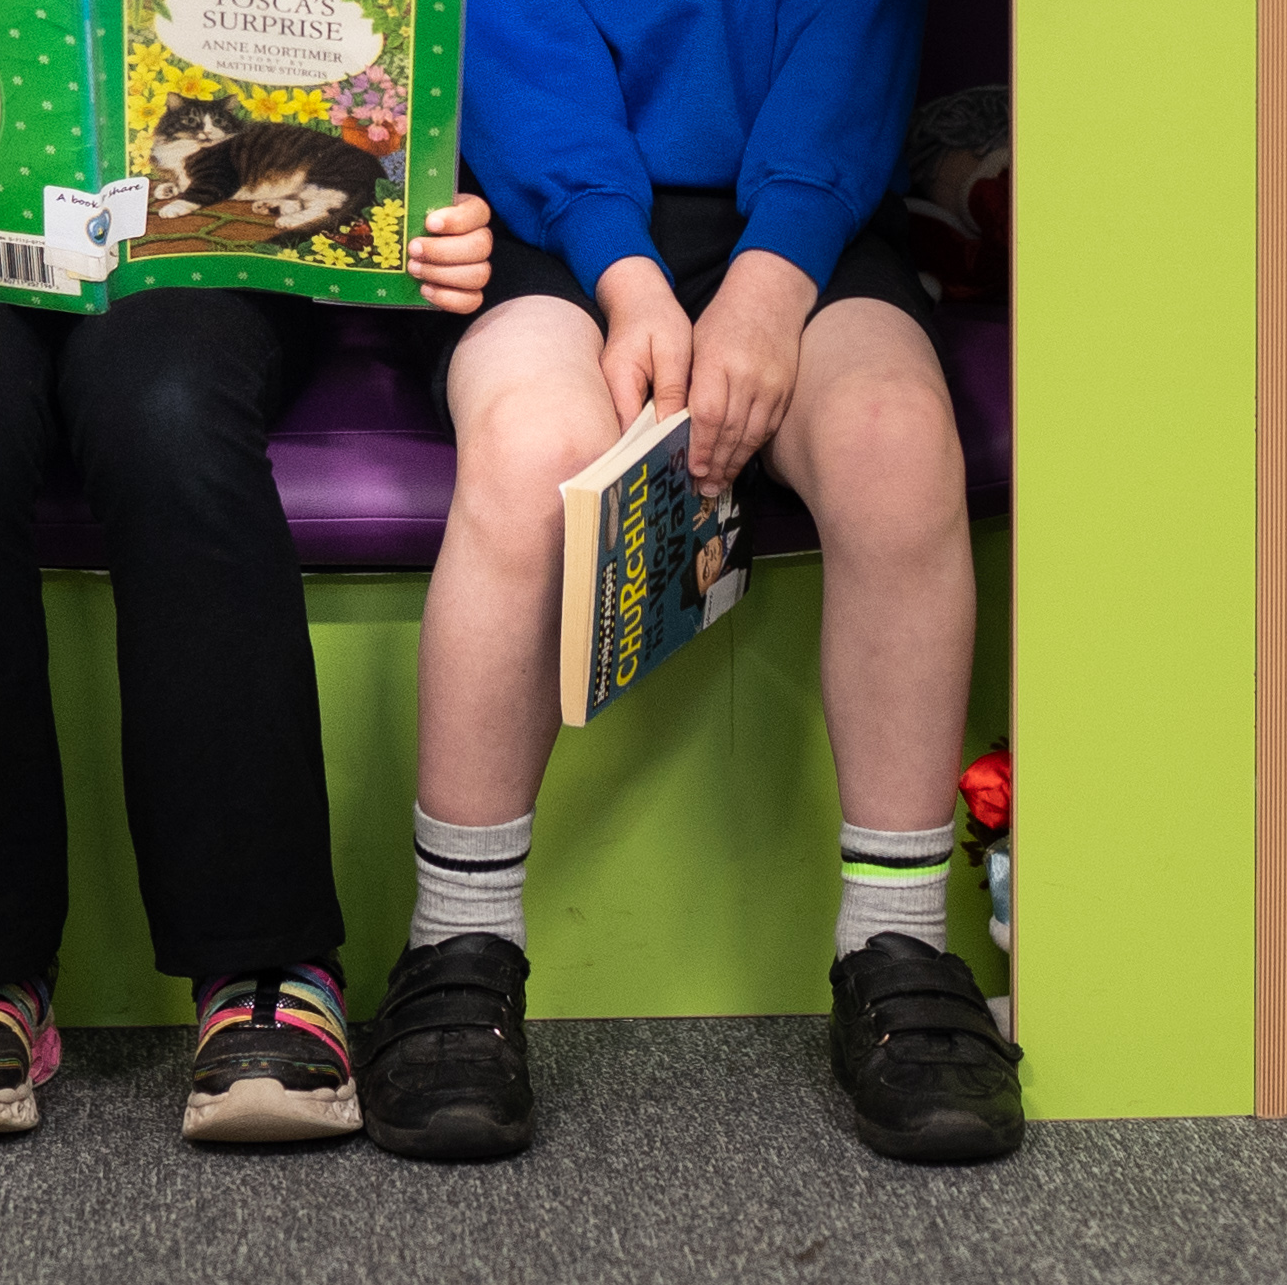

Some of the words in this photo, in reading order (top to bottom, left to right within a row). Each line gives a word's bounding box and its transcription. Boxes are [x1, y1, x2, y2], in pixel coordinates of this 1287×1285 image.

[202, 10, 344, 42] SURPRISE
[202, 40, 249, 54] ANNE
[253, 43, 343, 64] MORTIMER
[216, 60, 277, 76] MATTHEW
[279, 65, 328, 80] STURGIS
[56, 193, 66, 202] A
[71, 195, 100, 209] book
[109, 182, 144, 199] share
[616, 463, 648, 688] CHURCHILL
